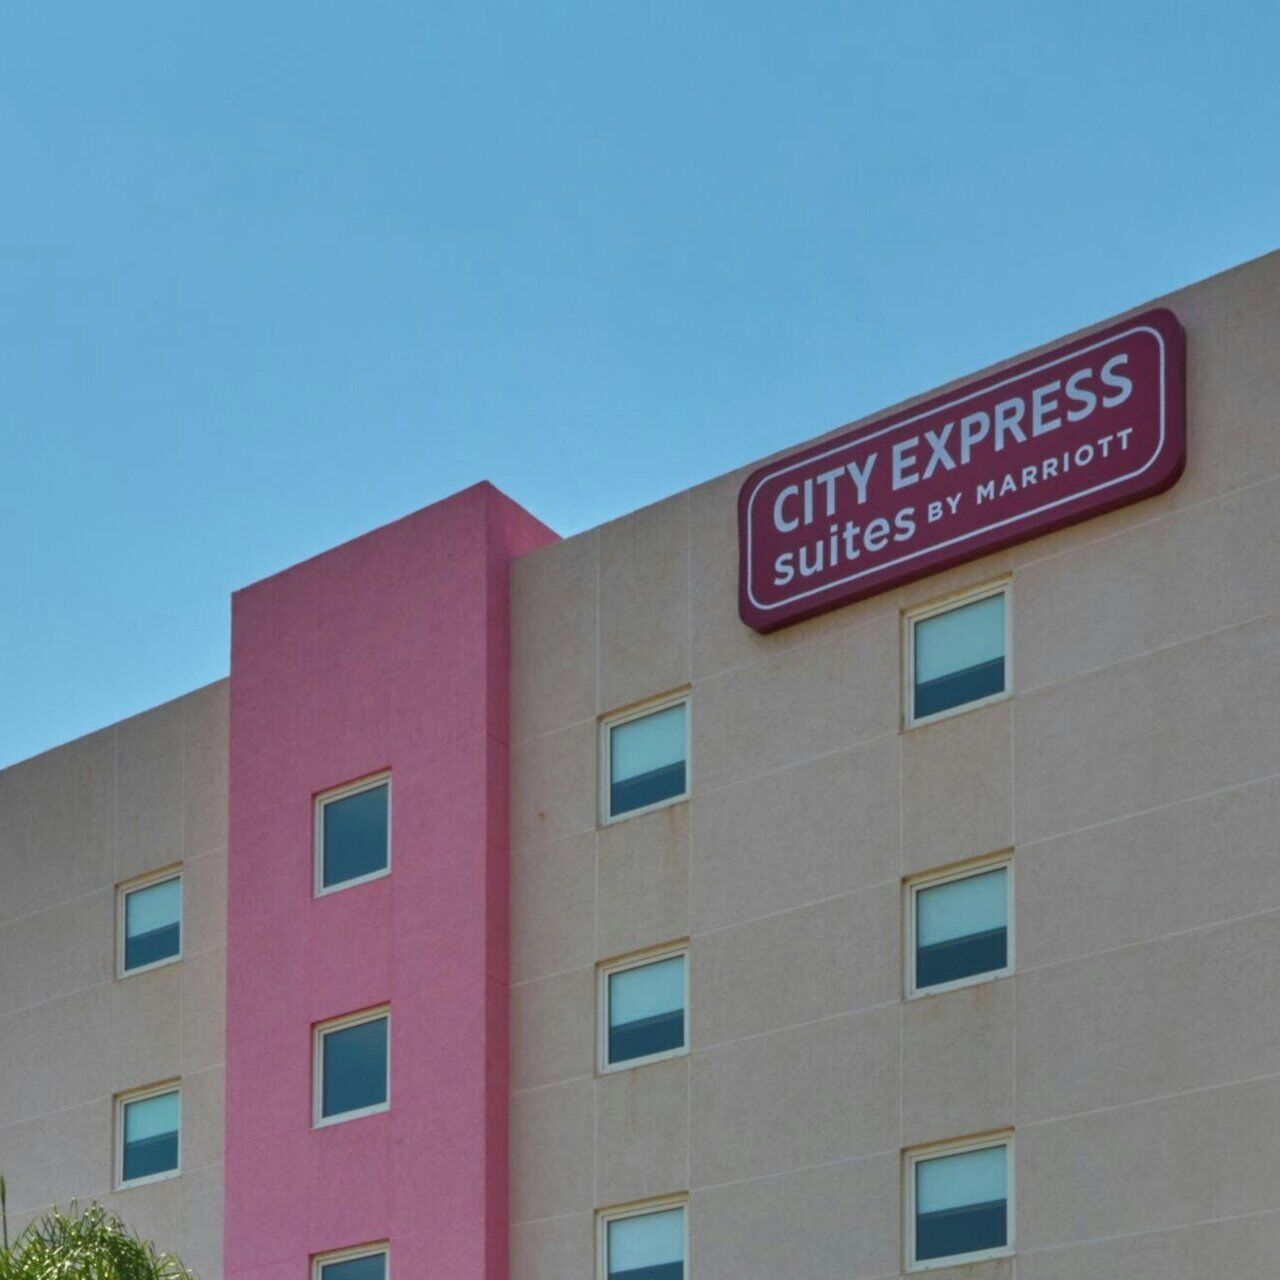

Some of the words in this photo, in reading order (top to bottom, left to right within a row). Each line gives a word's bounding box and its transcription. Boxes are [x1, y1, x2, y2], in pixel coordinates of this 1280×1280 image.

[773, 452, 878, 533] CITY
[891, 353, 1133, 491] EXPRESS
[773, 507, 917, 586] suites
[927, 492, 963, 524] BY
[976, 427, 1133, 505] MARRIOTT
